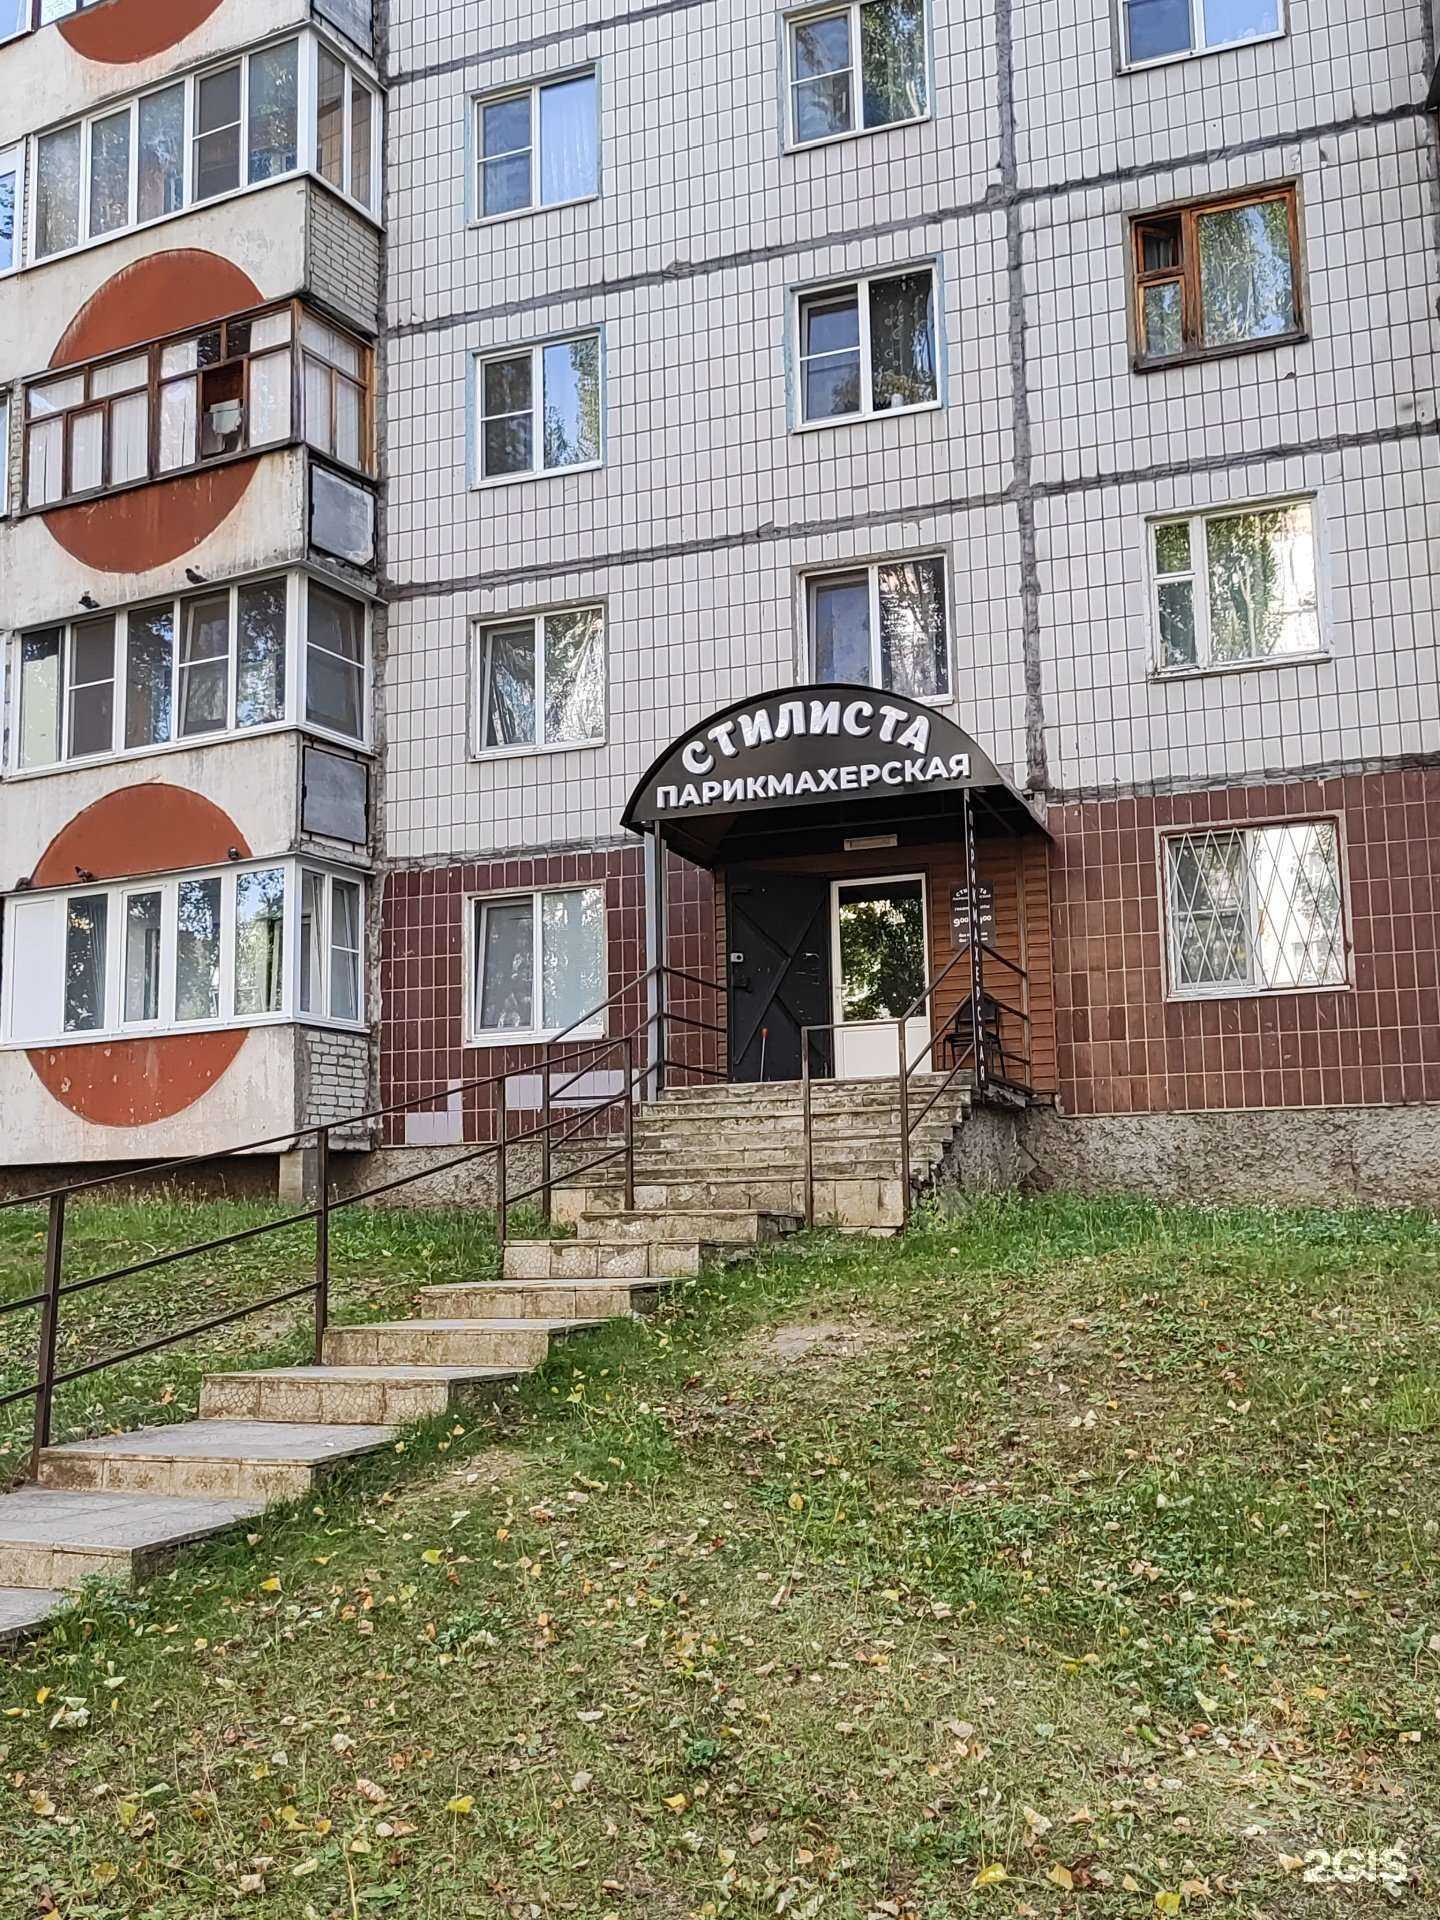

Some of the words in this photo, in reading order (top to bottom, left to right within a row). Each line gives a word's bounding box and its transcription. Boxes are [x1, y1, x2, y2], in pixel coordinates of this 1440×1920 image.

[681, 699, 932, 775] СТИЛИСТА
[656, 752, 970, 808] ПАРИКМАХЕРСКАЯ
[968, 809, 985, 1081] ПАРИКМАХЕРСКАЯ
